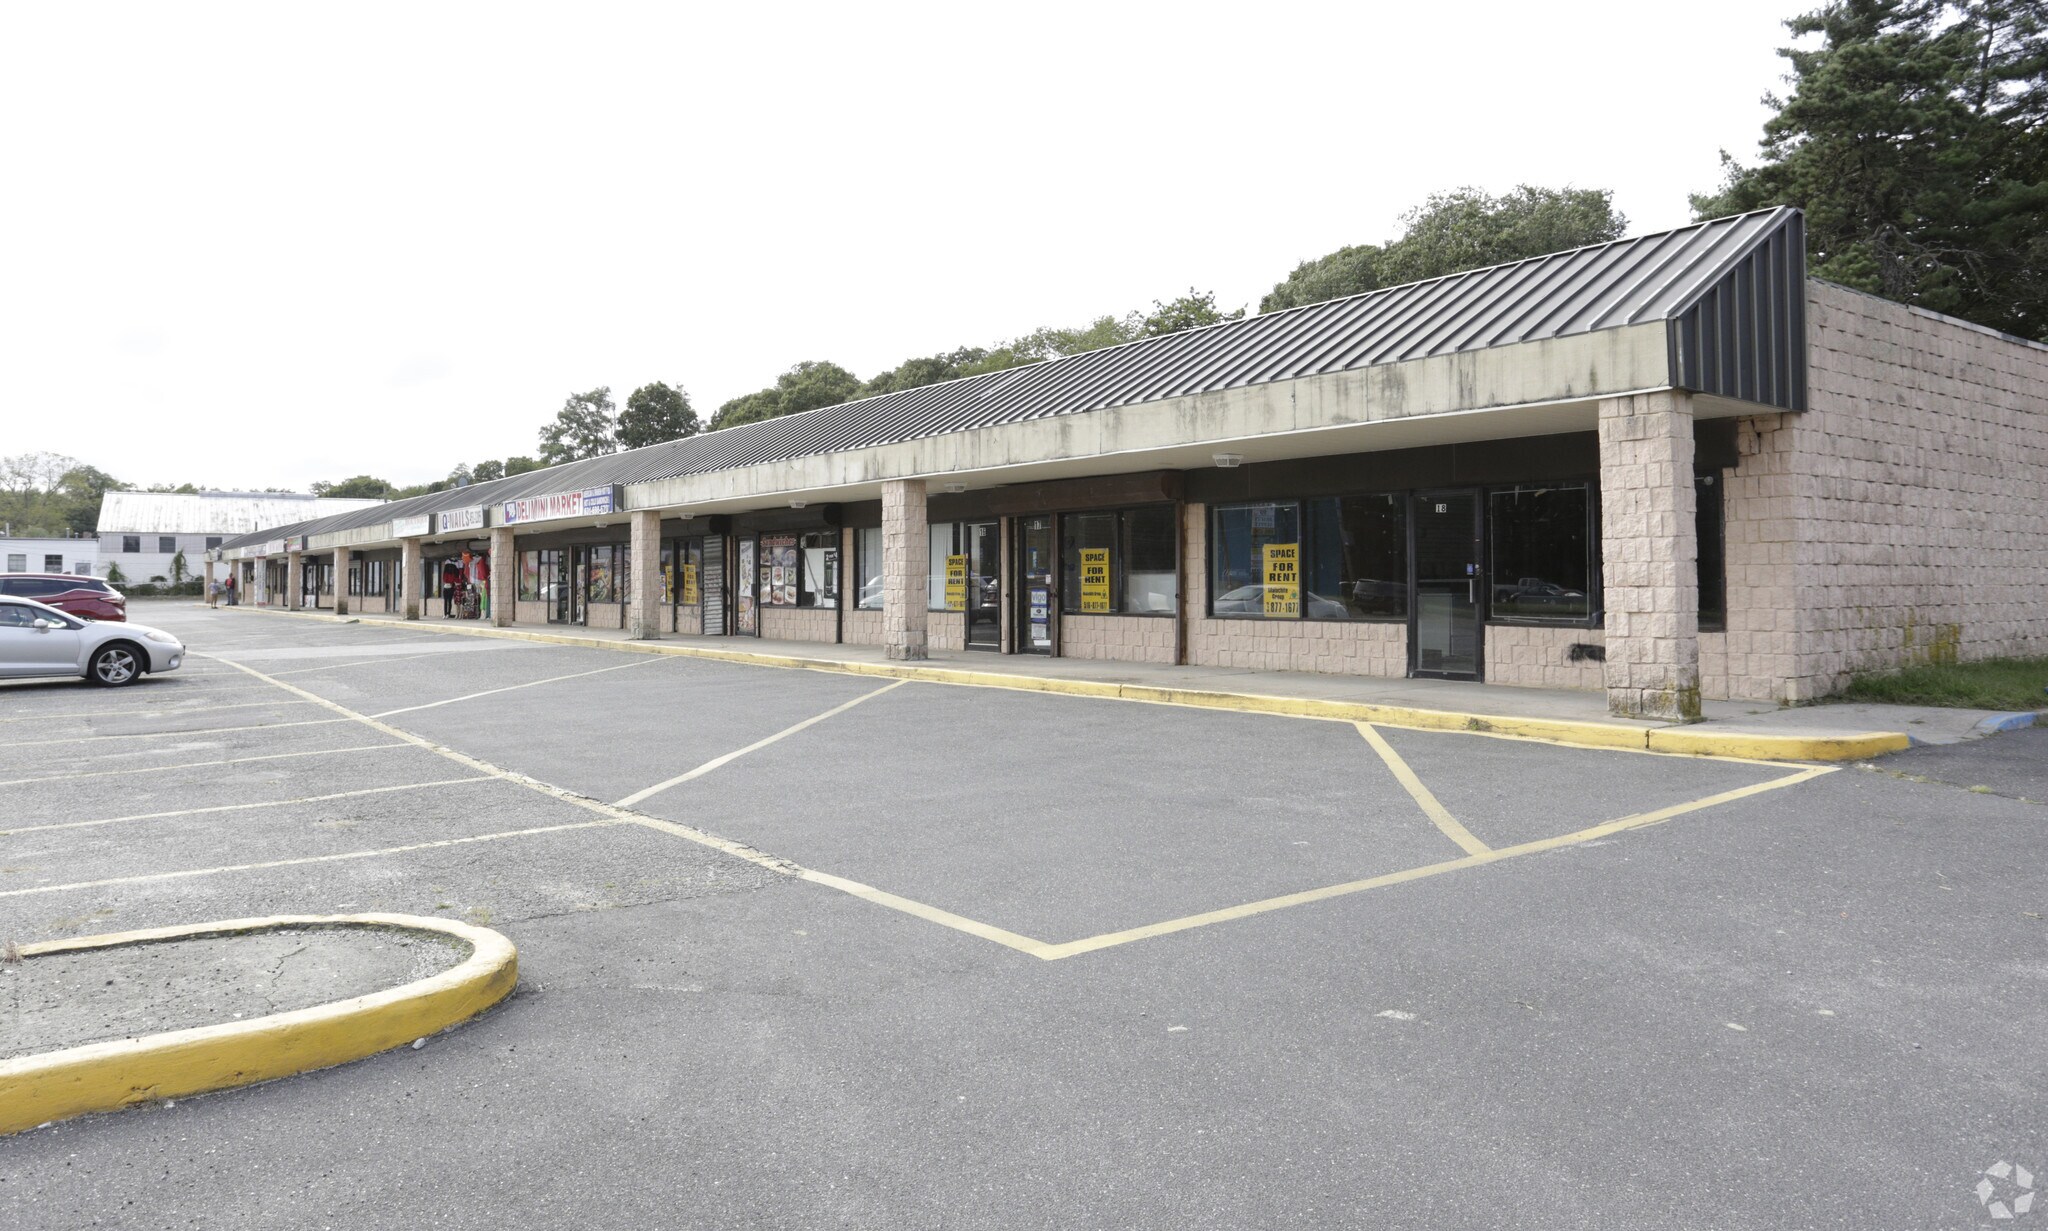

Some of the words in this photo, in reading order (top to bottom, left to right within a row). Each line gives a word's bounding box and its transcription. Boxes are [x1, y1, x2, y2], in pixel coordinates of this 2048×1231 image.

[549, 493, 582, 516] MARKET
[1437, 504, 1446, 512] 18
[760, 536, 796, 547] Sandwiches
[1085, 553, 1105, 561] SPACE
[1270, 549, 1295, 558] SPACE
[949, 558, 964, 566] SPACE
[1273, 563, 1293, 571] FOR
[1269, 573, 1296, 582] RENT
